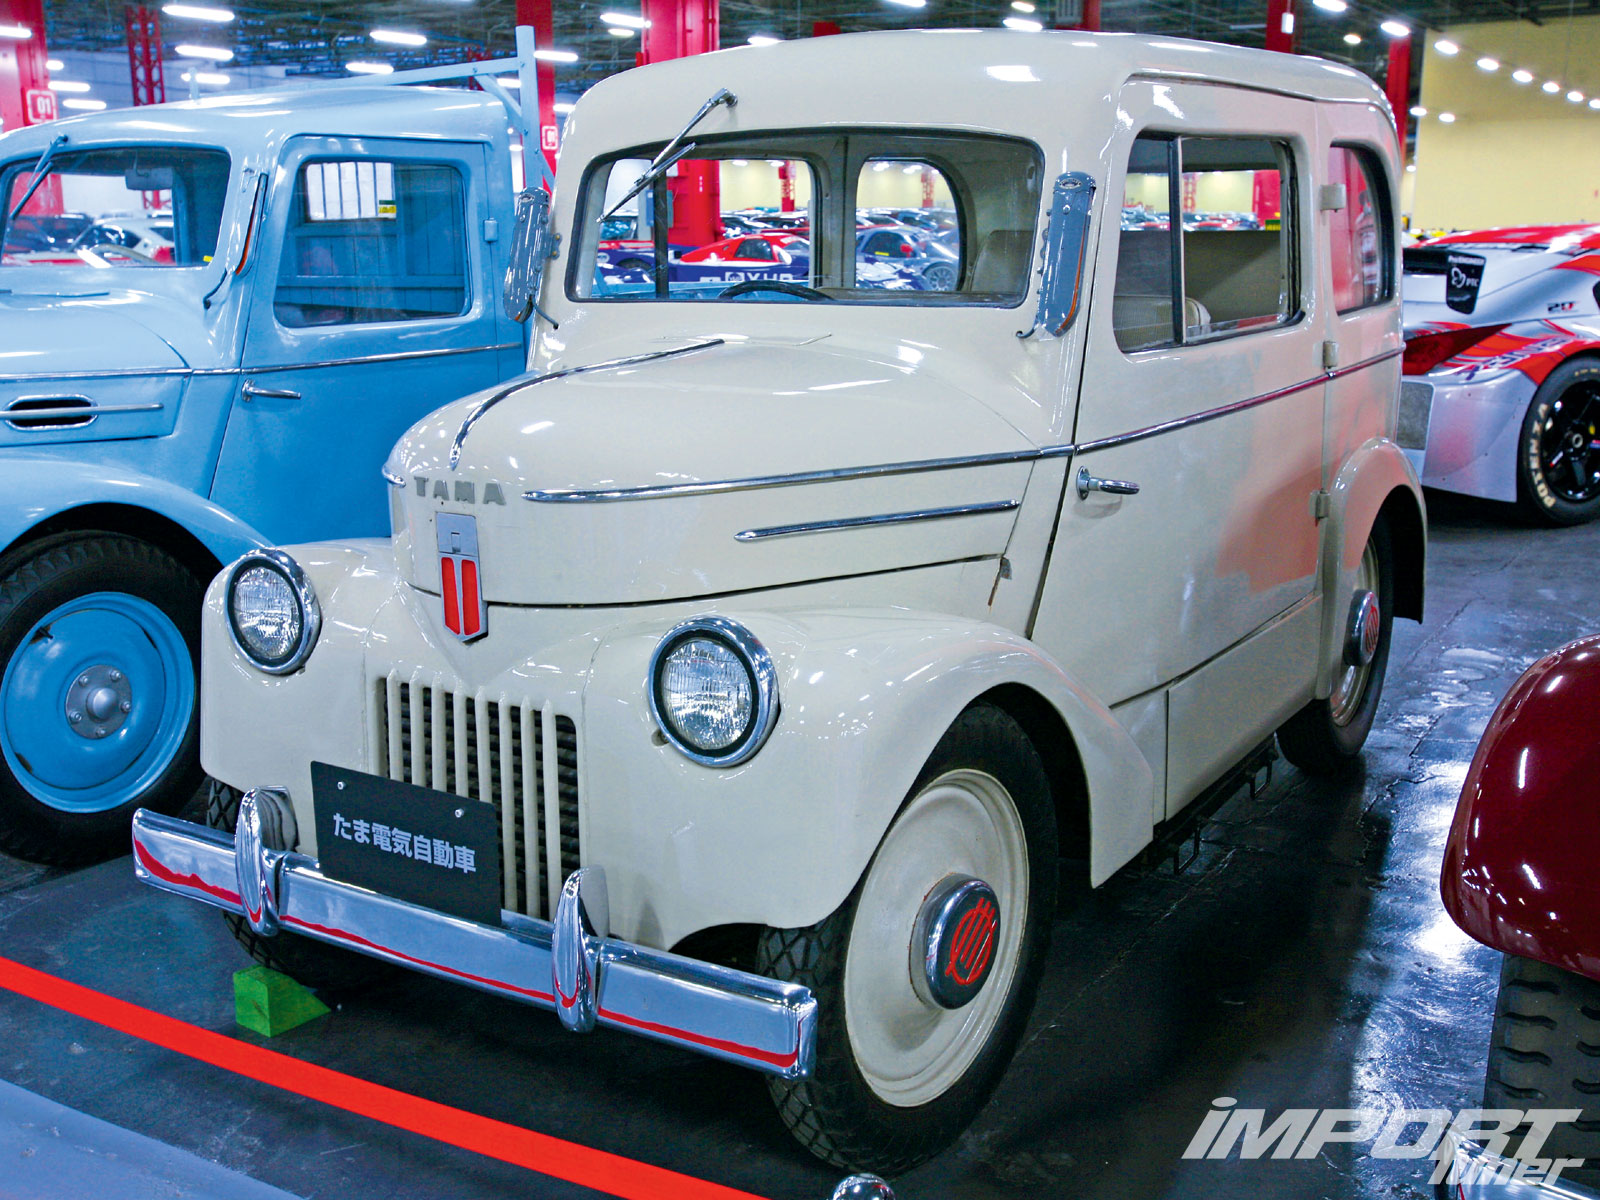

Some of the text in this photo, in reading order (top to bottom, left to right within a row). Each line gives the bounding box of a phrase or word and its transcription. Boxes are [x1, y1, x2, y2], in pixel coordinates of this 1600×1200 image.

[37, 96, 52, 115] 01
[1529, 403, 1556, 508] POTENZA
[413, 476, 507, 506] TAMA
[332, 812, 477, 874] たま電気自動車
